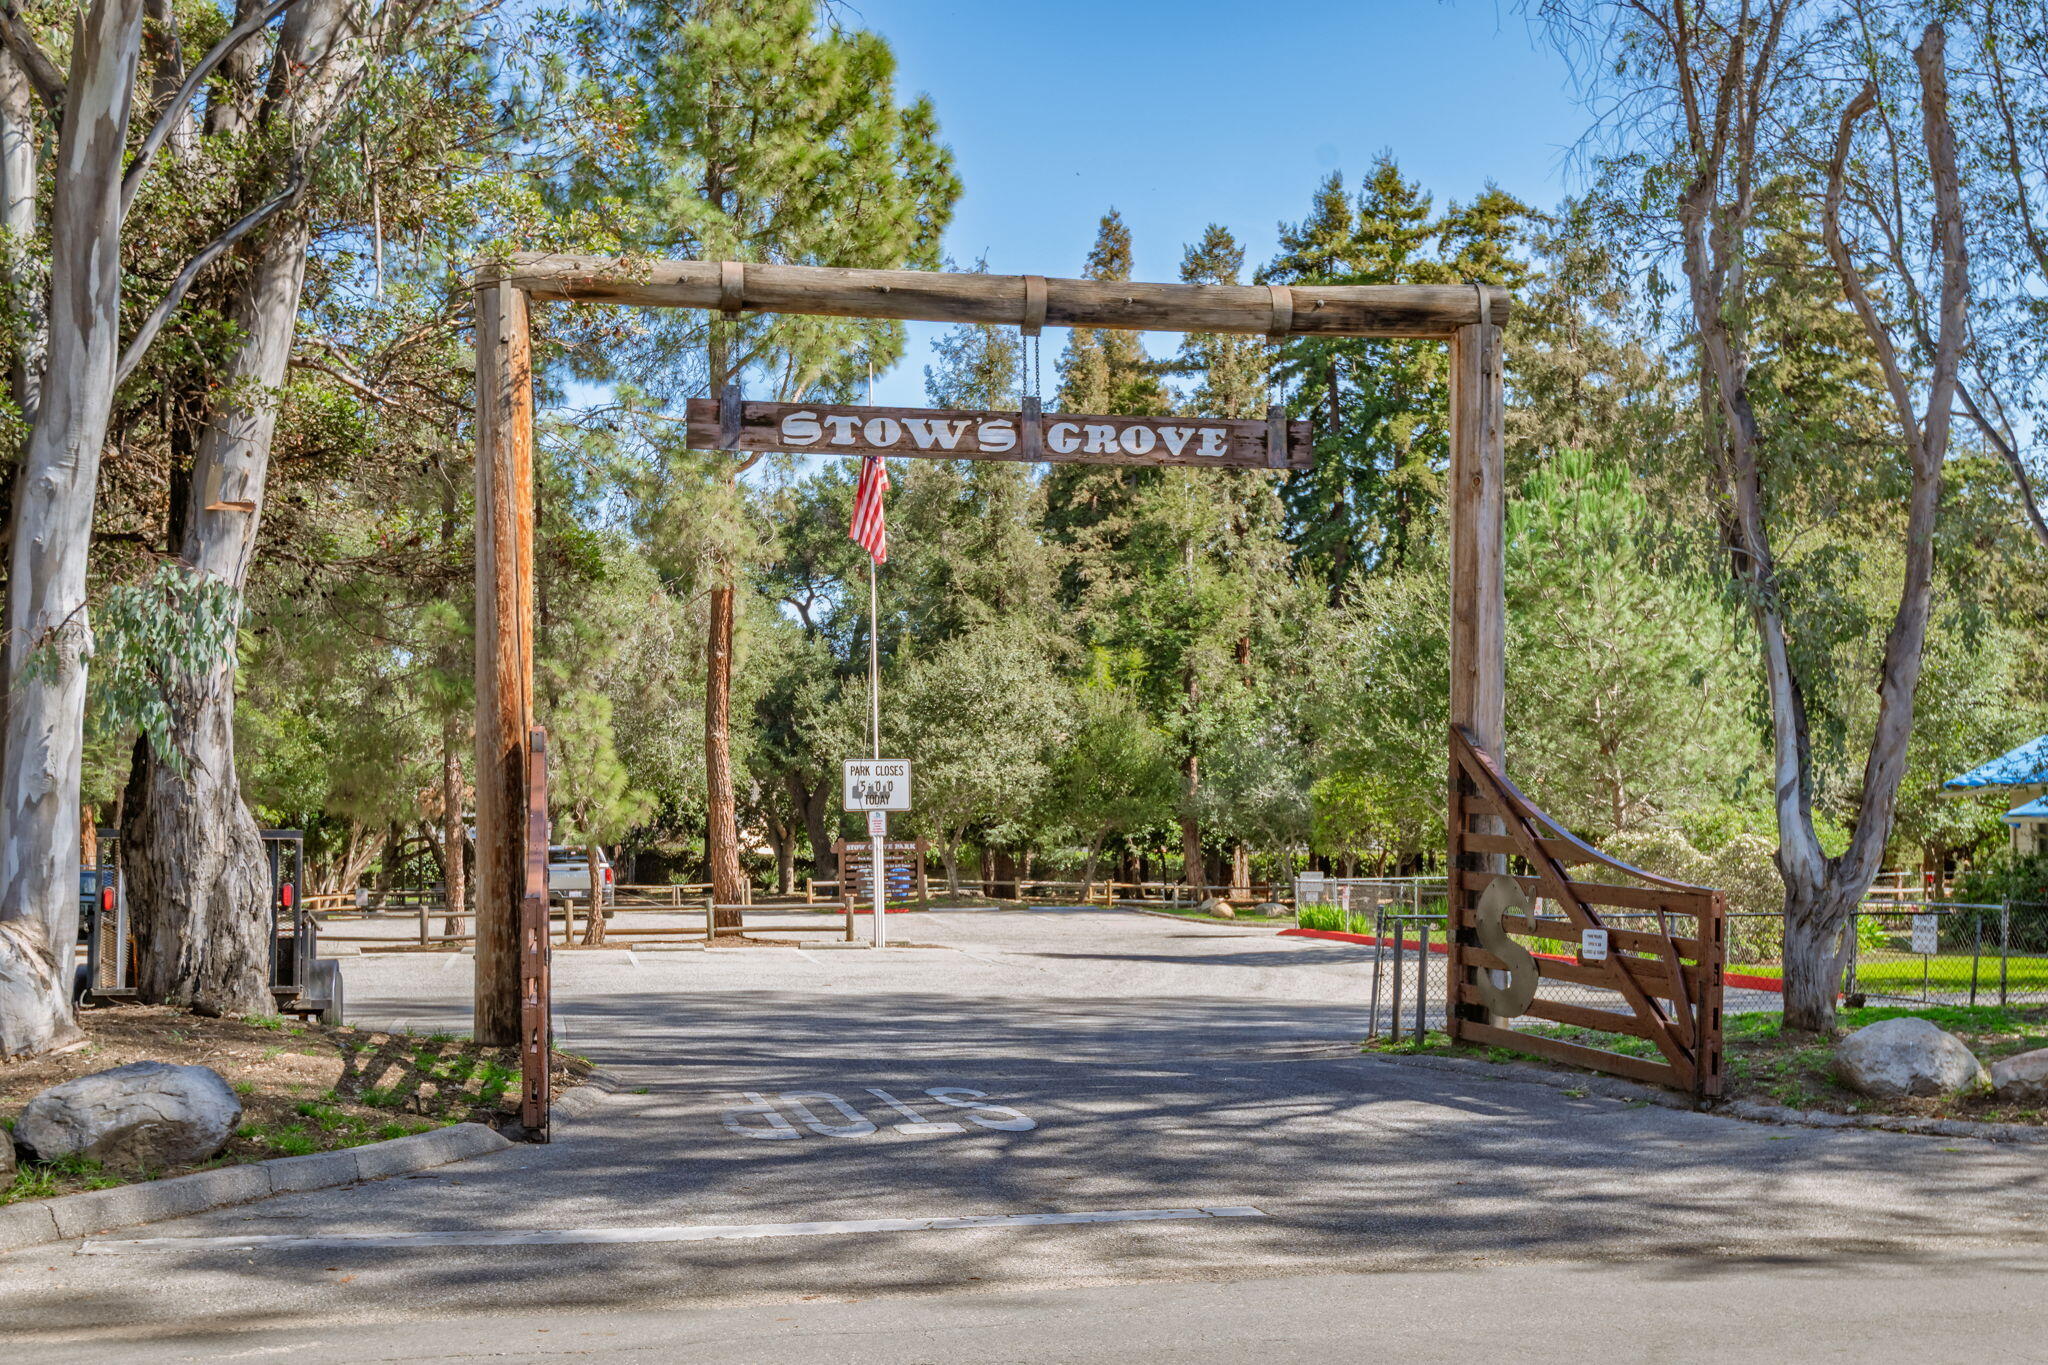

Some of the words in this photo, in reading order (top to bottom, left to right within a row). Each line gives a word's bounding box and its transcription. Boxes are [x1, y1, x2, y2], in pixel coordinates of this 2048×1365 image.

[781, 410, 1016, 453] STOW'S
[1047, 420, 1231, 458] GROVE
[850, 765, 870, 777] PARK
[875, 765, 904, 777] CLOSES
[864, 794, 891, 806] TODAY
[722, 1086, 1038, 1140] STOP
